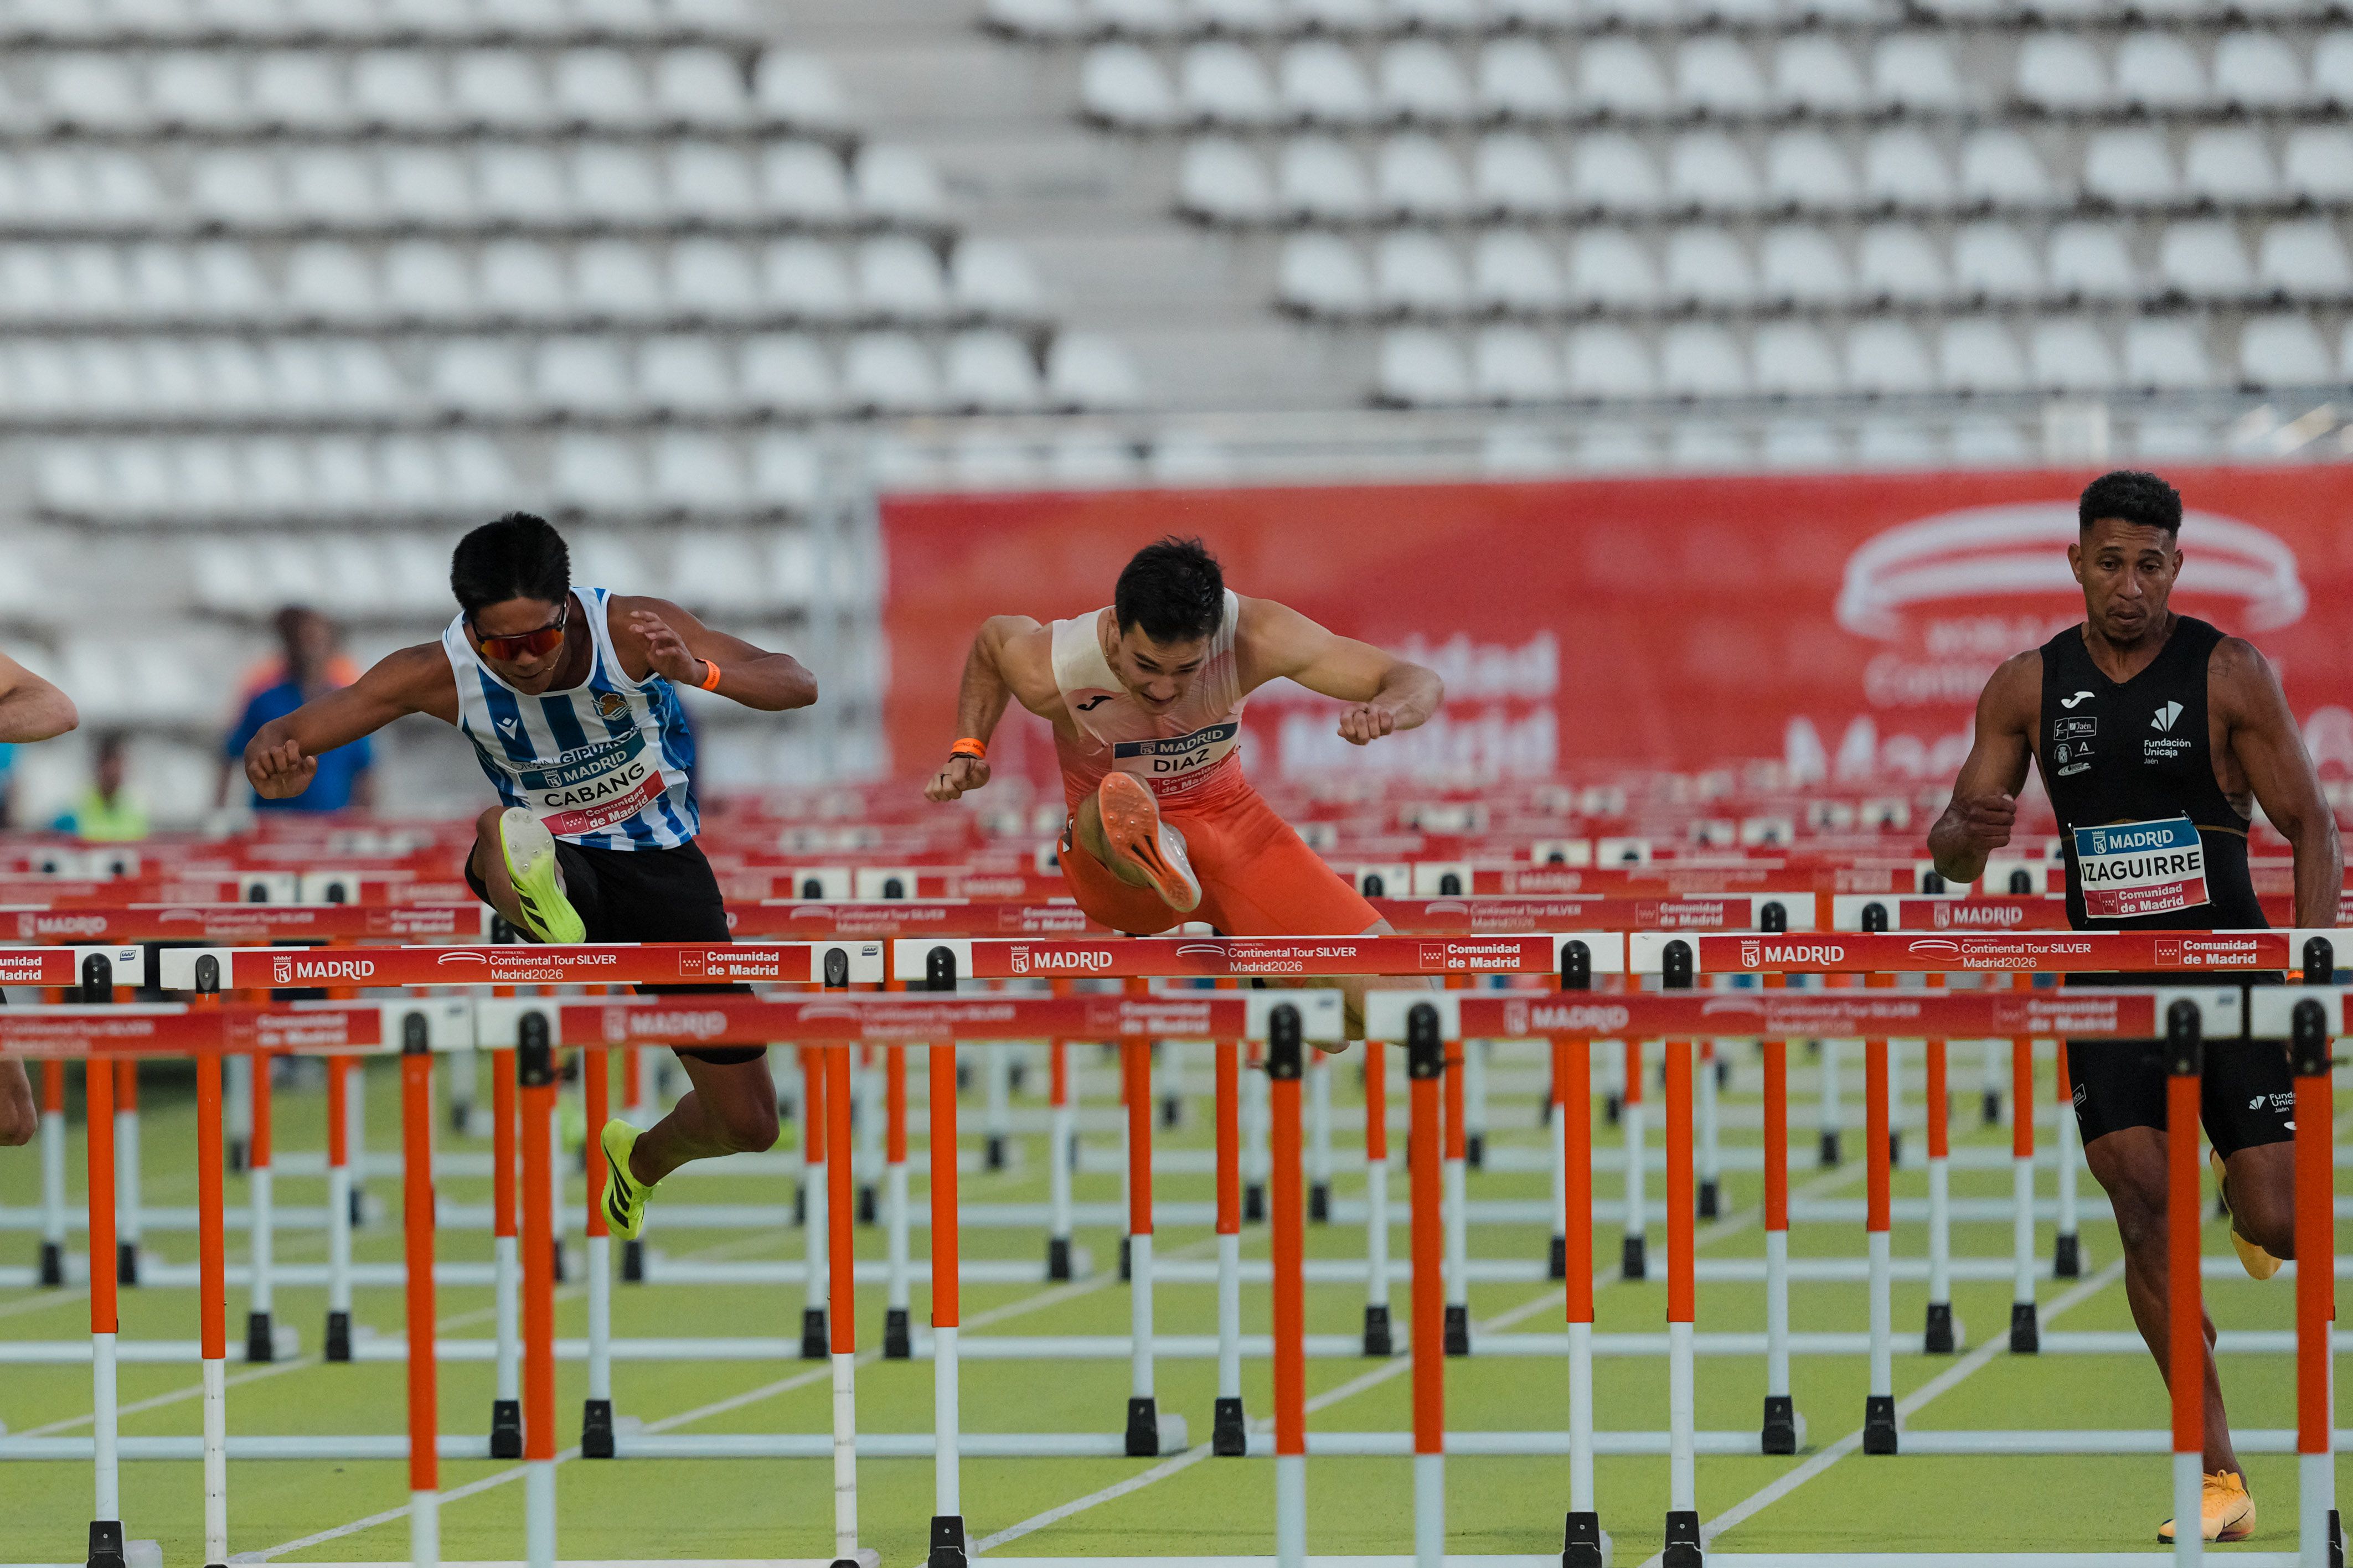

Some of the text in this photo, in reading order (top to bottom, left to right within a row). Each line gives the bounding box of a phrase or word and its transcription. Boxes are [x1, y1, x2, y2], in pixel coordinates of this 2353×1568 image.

[1160, 729, 1224, 753] MADRID
[2144, 738, 2191, 748] Fundación
[2144, 748, 2178, 758] Unicaja
[1154, 748, 1210, 772] DIAZ
[563, 751, 627, 782] MADRID
[544, 763, 645, 807] CABANG
[585, 786, 645, 817] Comunidad
[590, 795, 649, 829] de Madrid
[2109, 830, 2174, 849] MADRID
[2081, 851, 2201, 881] IZAGUIRRE
[2118, 884, 2183, 900] Comunidad
[2120, 896, 2184, 913] de Madrid
[1678, 914, 1724, 926] Madrid
[1953, 906, 2023, 927] MADRID
[1447, 944, 1521, 954] Comunidad
[1961, 943, 2092, 954] Continental Tour SILVER
[2183, 940, 2257, 950] Comunidad
[707, 951, 780, 961] Comunidad
[1228, 947, 1357, 958] Continental Tour SILVER
[1764, 945, 1845, 965] MADRID
[489, 954, 617, 966] Continental Tour SILVER
[1034, 951, 1113, 971] MADRID
[1447, 957, 1520, 968] de Madrid
[1963, 958, 2037, 967] Madrid2026
[2183, 954, 2257, 965] de Madrid
[297, 960, 375, 980] MADRID
[707, 964, 779, 976] de Madrid
[1230, 961, 1303, 972] Madrid2026
[491, 969, 564, 980] Madrid2026
